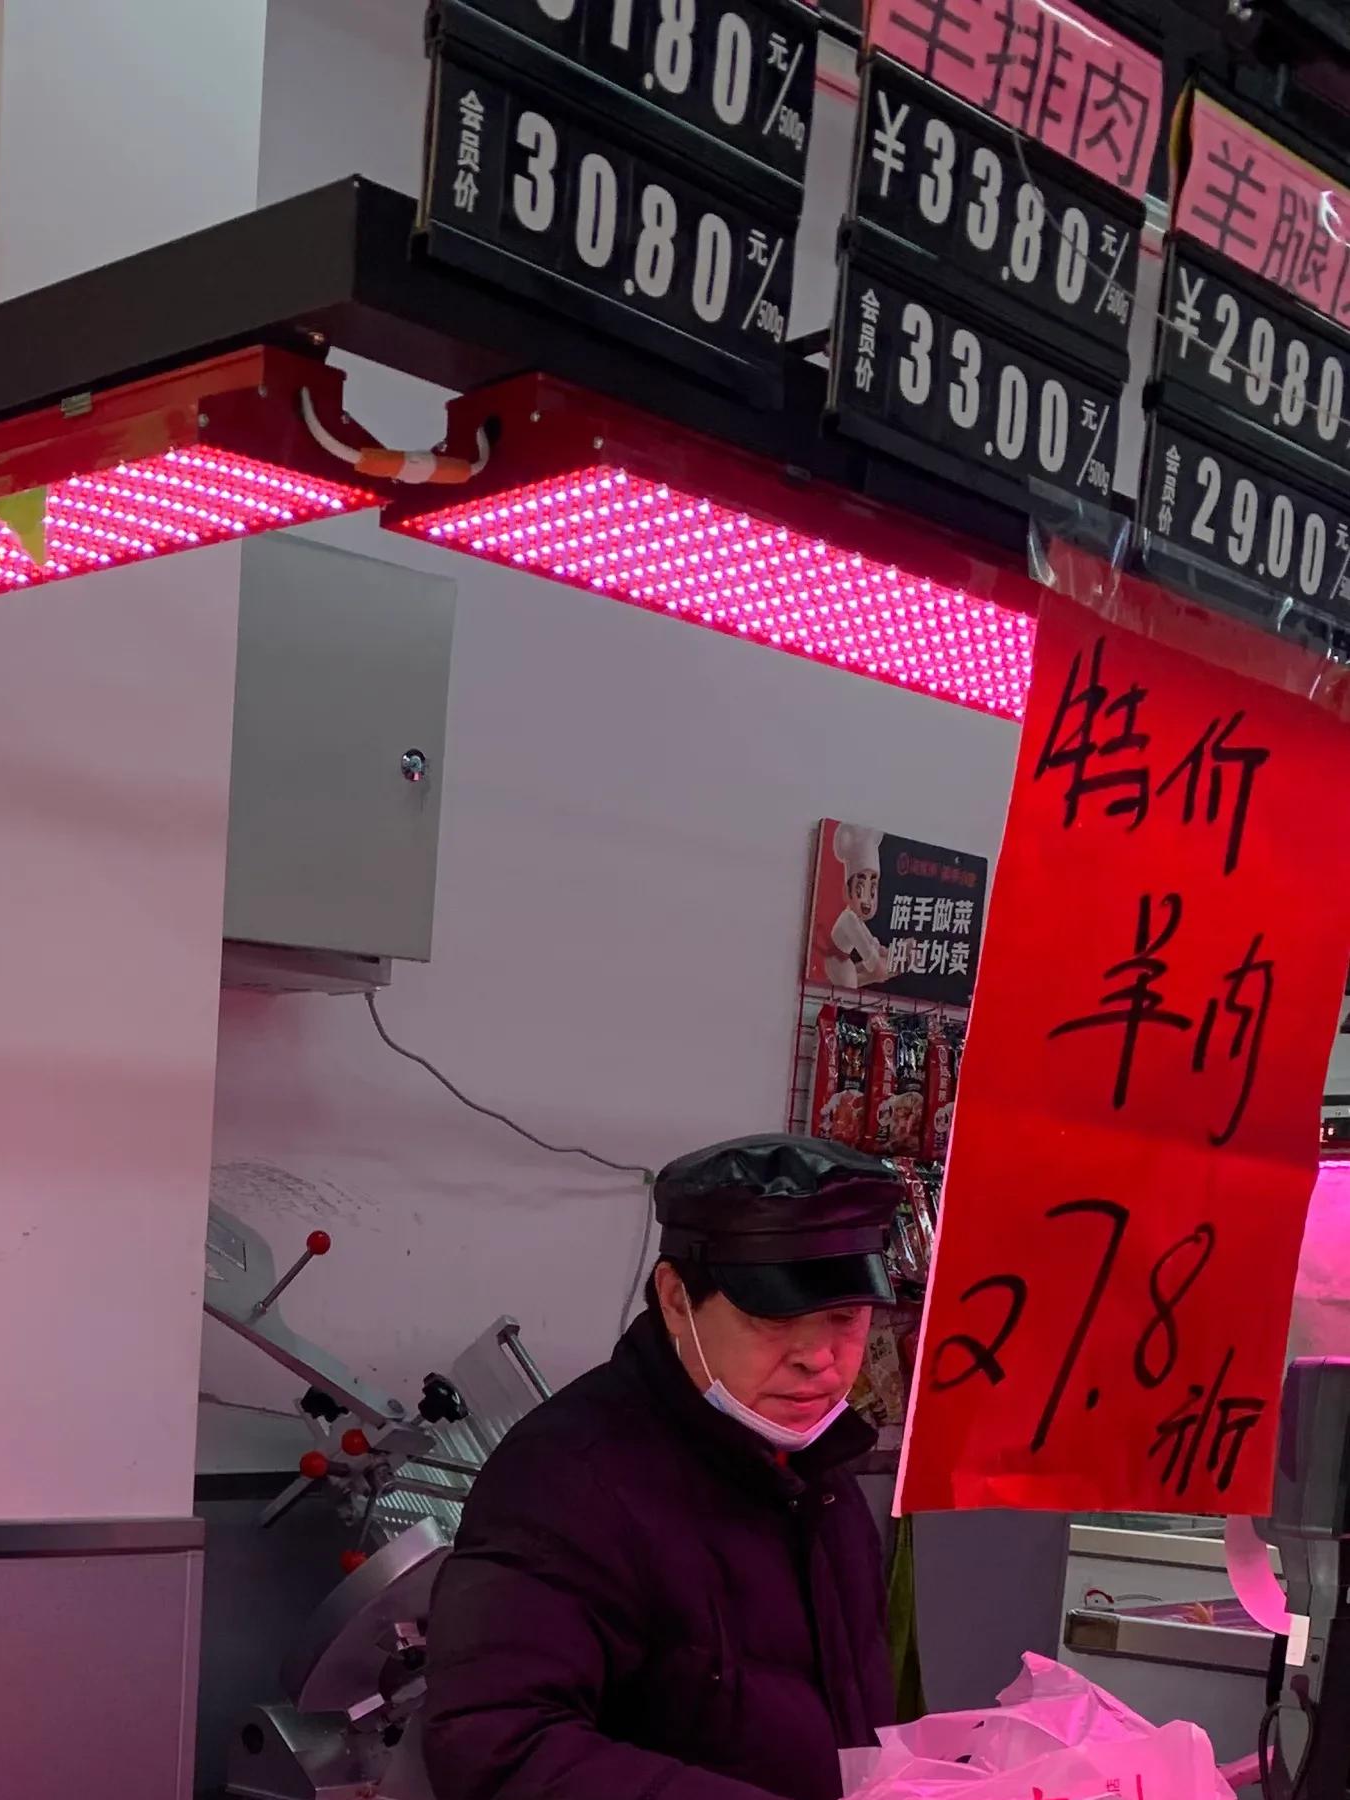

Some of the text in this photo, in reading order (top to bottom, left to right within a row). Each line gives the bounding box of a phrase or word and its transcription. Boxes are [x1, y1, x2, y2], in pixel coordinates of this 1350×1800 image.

[513, 111, 732, 323] 30.80
[873, 91, 1089, 304] ¥33.80
[899, 303, 1068, 473] 33.00
[1174, 267, 1344, 441] ¥29.80
[1191, 457, 1326, 595] 29.00
[1035, 636, 1271, 878] 特价
[886, 937, 971, 976] 快过外卖
[890, 894, 975, 935] 筷手做菜
[1048, 892, 1274, 1146] 羊肉
[930, 1200, 1216, 1453] 27.8
